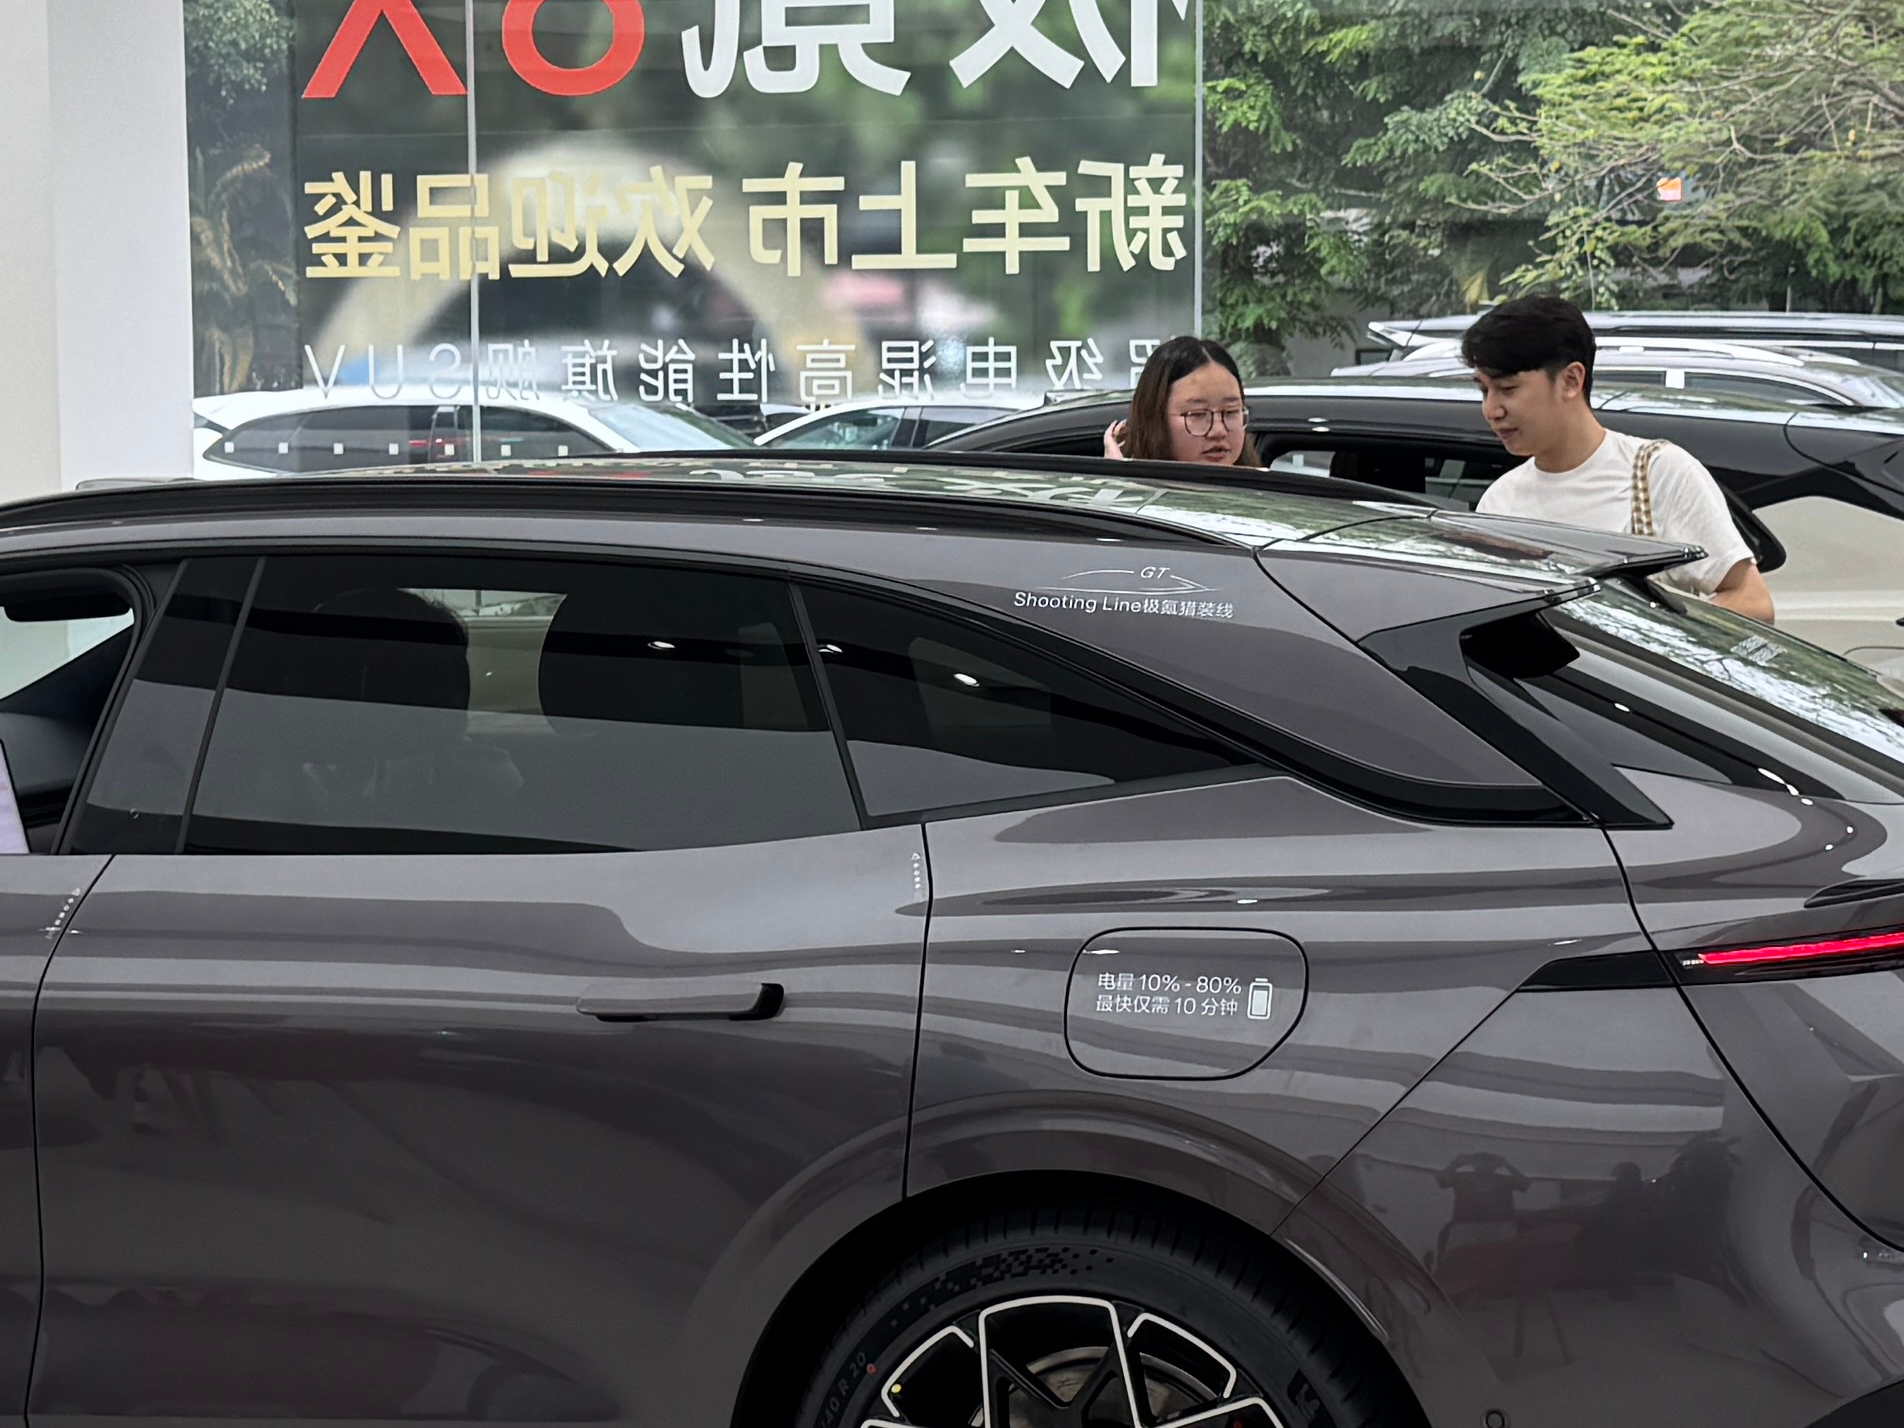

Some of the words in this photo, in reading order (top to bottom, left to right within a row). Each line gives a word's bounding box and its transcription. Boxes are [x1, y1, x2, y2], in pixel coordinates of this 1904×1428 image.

[1140, 566, 1171, 580] GT
[1014, 591, 1097, 614] Shooting
[1097, 972, 1134, 991] 电量
[1139, 974, 1181, 992] 10%
[1196, 976, 1242, 995] 80%
[1096, 994, 1170, 1015] 最快仅需
[1174, 997, 1196, 1015] 10
[1201, 998, 1238, 1017] 分钟
[849, 1351, 866, 1377] 20
